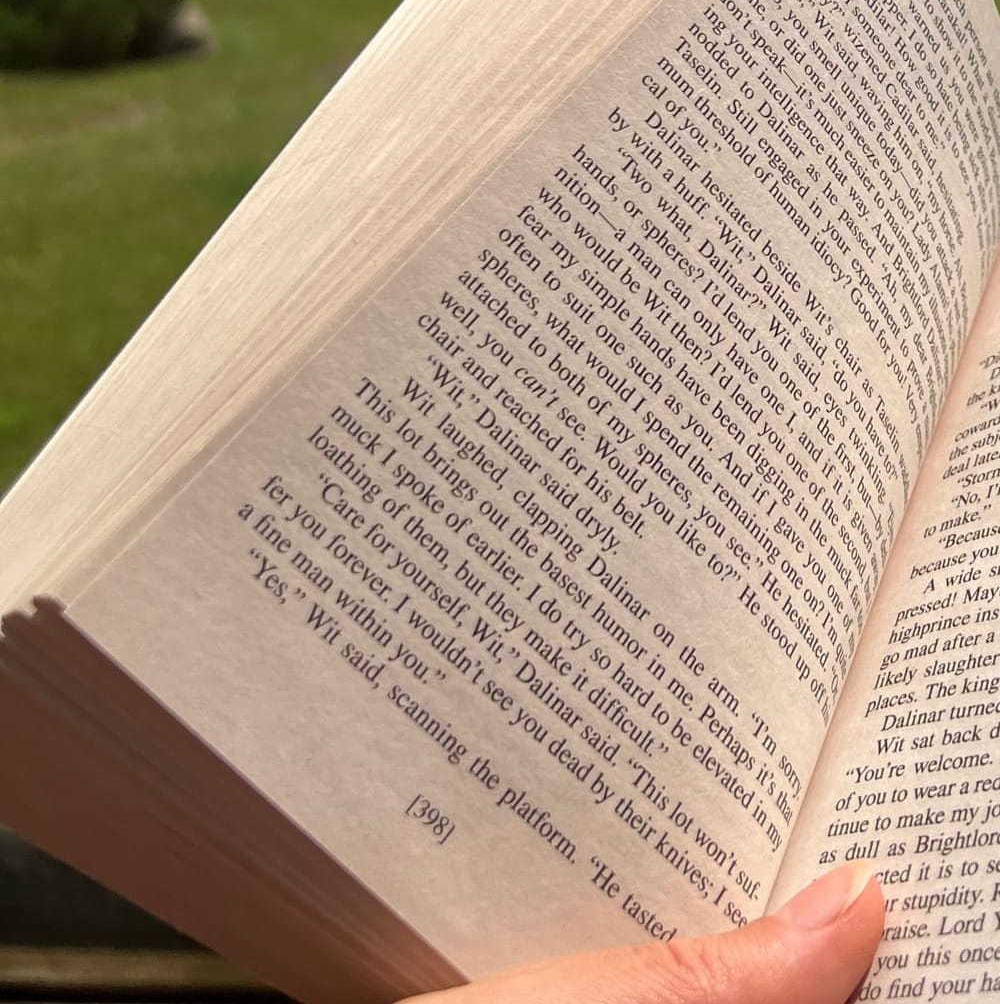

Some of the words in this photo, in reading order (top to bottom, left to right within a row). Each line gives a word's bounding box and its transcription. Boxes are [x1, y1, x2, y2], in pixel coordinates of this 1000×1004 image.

[844, 22, 887, 84] wizened
[885, 82, 919, 137] Cadilar
[917, 138, 936, 175] said,
[851, 6, 895, 69] someone
[895, 70, 917, 102] dear
[915, 102, 925, 120] to
[641, 74, 667, 99] cal
[664, 99, 687, 117] of
[677, 117, 721, 152] you.”
[644, 110, 700, 172] Dalinar
[700, 170, 762, 242] hesitated
[761, 239, 800, 292] beside
[805, 289, 833, 335] Wit’s
[834, 337, 862, 376] chair
[861, 378, 873, 398] as
[875, 394, 899, 453] Taselin
[417, 314, 464, 356] chair
[461, 356, 499, 390] and
[494, 387, 563, 452] reached
[559, 446, 586, 476] for
[584, 469, 612, 502] his
[611, 495, 644, 538] belt.
[427, 355, 480, 408] “Wit,”
[474, 406, 541, 473] Dalinar
[538, 472, 579, 509] said
[575, 506, 620, 554] dryly.
[923, 524, 936, 539] to
[939, 504, 991, 533] make.”
[951, 491, 980, 507] “No,
[237, 503, 253, 520] a
[252, 514, 291, 553] fine
[290, 551, 333, 593] man
[335, 589, 392, 647] within
[387, 643, 446, 684] you.”
[307, 424, 382, 503] loathing
[382, 498, 410, 519] of
[403, 515, 448, 570] them,
[454, 559, 486, 596] but
[484, 591, 525, 632] they
[523, 628, 571, 676] make
[571, 668, 588, 691] it
[587, 687, 668, 757] difficult.”
[922, 578, 935, 593] A
[945, 567, 981, 587] wide
[319, 473, 364, 528] “Care
[363, 523, 395, 554] for
[386, 551, 470, 627] yourself,
[471, 616, 520, 663] Wit,”
[515, 660, 582, 728] Dalinar
[579, 725, 620, 766] said.
[628, 758, 669, 811] “This
[667, 801, 693, 833] lot
[694, 827, 736, 876] won’t
[880, 708, 946, 731] Dalinar
[249, 548, 305, 604] “Yes,”
[306, 602, 341, 645] Wit
[340, 643, 385, 689] said,
[386, 685, 467, 764] scanning
[469, 757, 499, 789] the
[495, 787, 575, 864] platform.
[590, 856, 619, 898] “He
[621, 893, 677, 942] tasted
[877, 736, 904, 754] Wit
[910, 733, 934, 749] sat
[941, 724, 982, 745] back
[405, 794, 455, 844] [398]
[881, 919, 931, 942] raise.
[937, 912, 985, 935] Lord
[886, 976, 925, 999] find
[927, 978, 976, 1001] your
